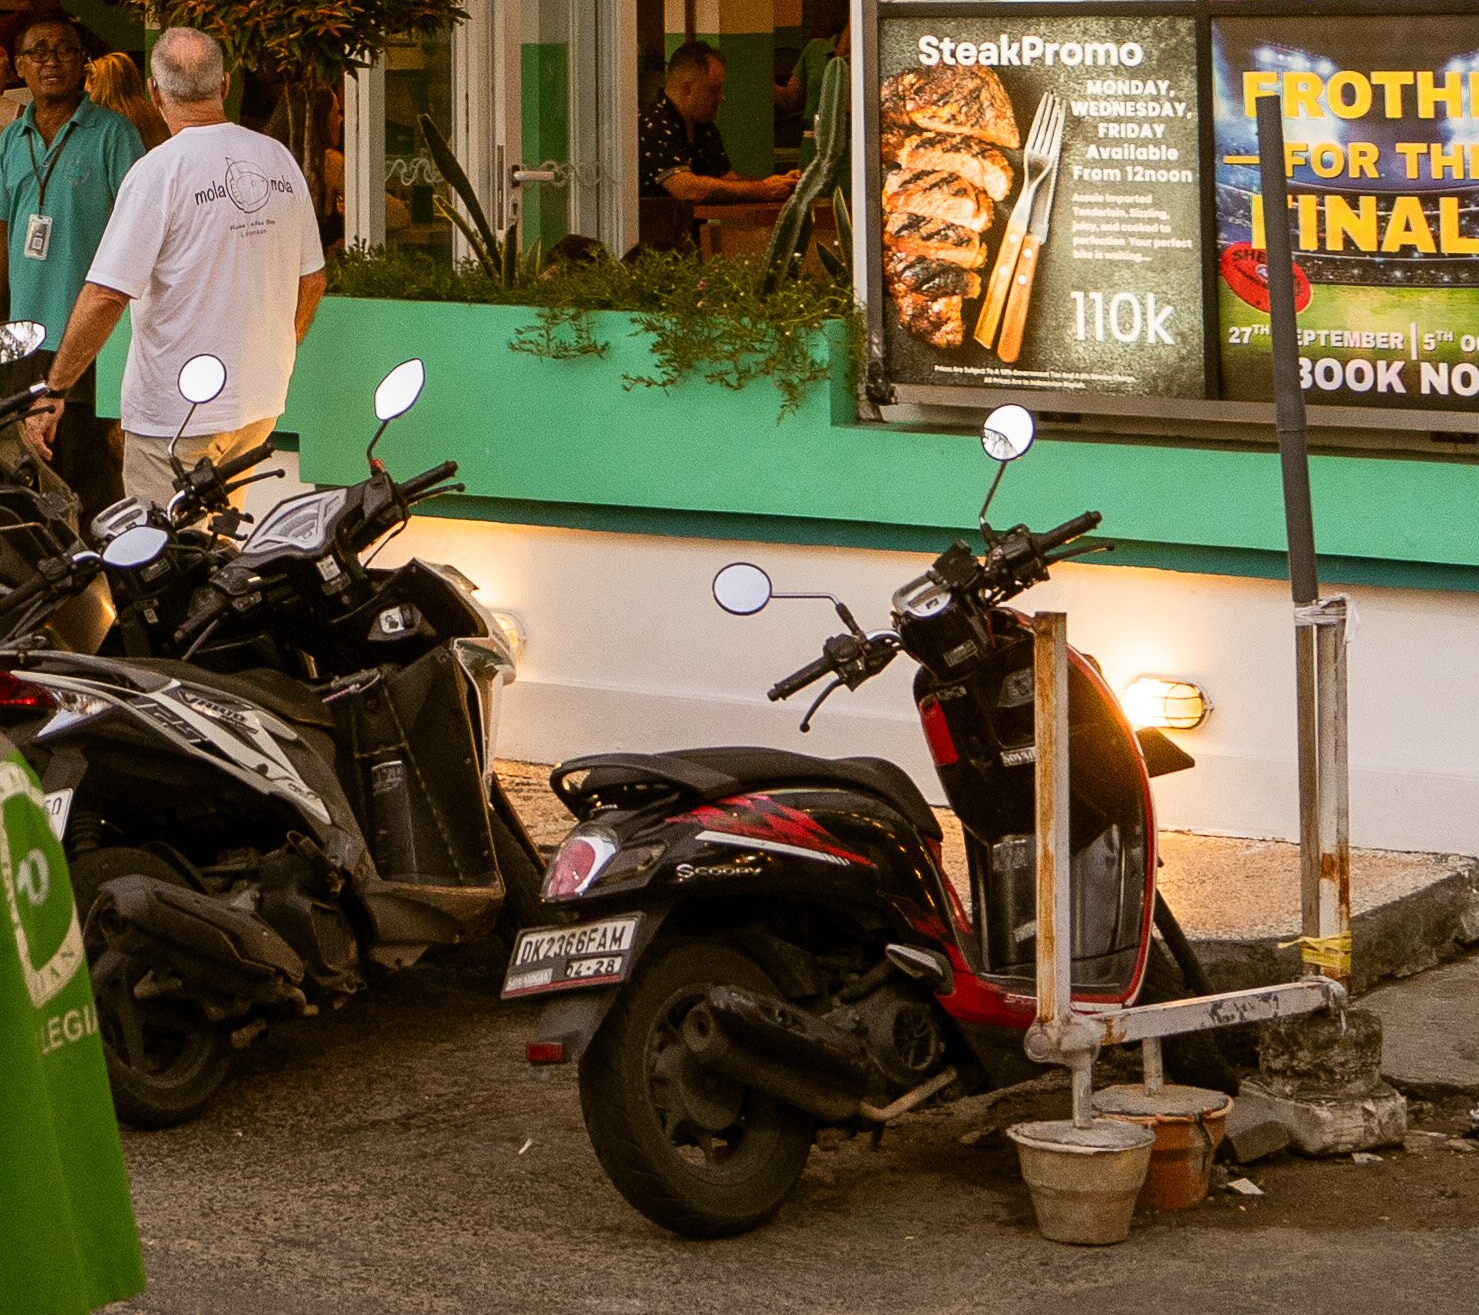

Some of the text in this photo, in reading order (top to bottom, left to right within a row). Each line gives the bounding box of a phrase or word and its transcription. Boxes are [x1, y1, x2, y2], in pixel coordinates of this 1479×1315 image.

[918, 34, 1144, 68] SteakPromo
[1086, 79, 1176, 98] MONDAY,
[1070, 101, 1193, 120] WEDNESDAY,
[1097, 122, 1166, 139] FRIDAY
[1086, 144, 1179, 162] Available
[1284, 141, 1380, 180] FOR
[1072, 165, 1194, 183] From 12noon
[194, 180, 227, 206] mola
[1070, 290, 1176, 346] 110k
[1298, 328, 1404, 350] EPTEMBER
[1299, 357, 1407, 394] BOOK
[675, 863, 762, 881] SCOOPY
[521, 926, 626, 964] DK2366FAM
